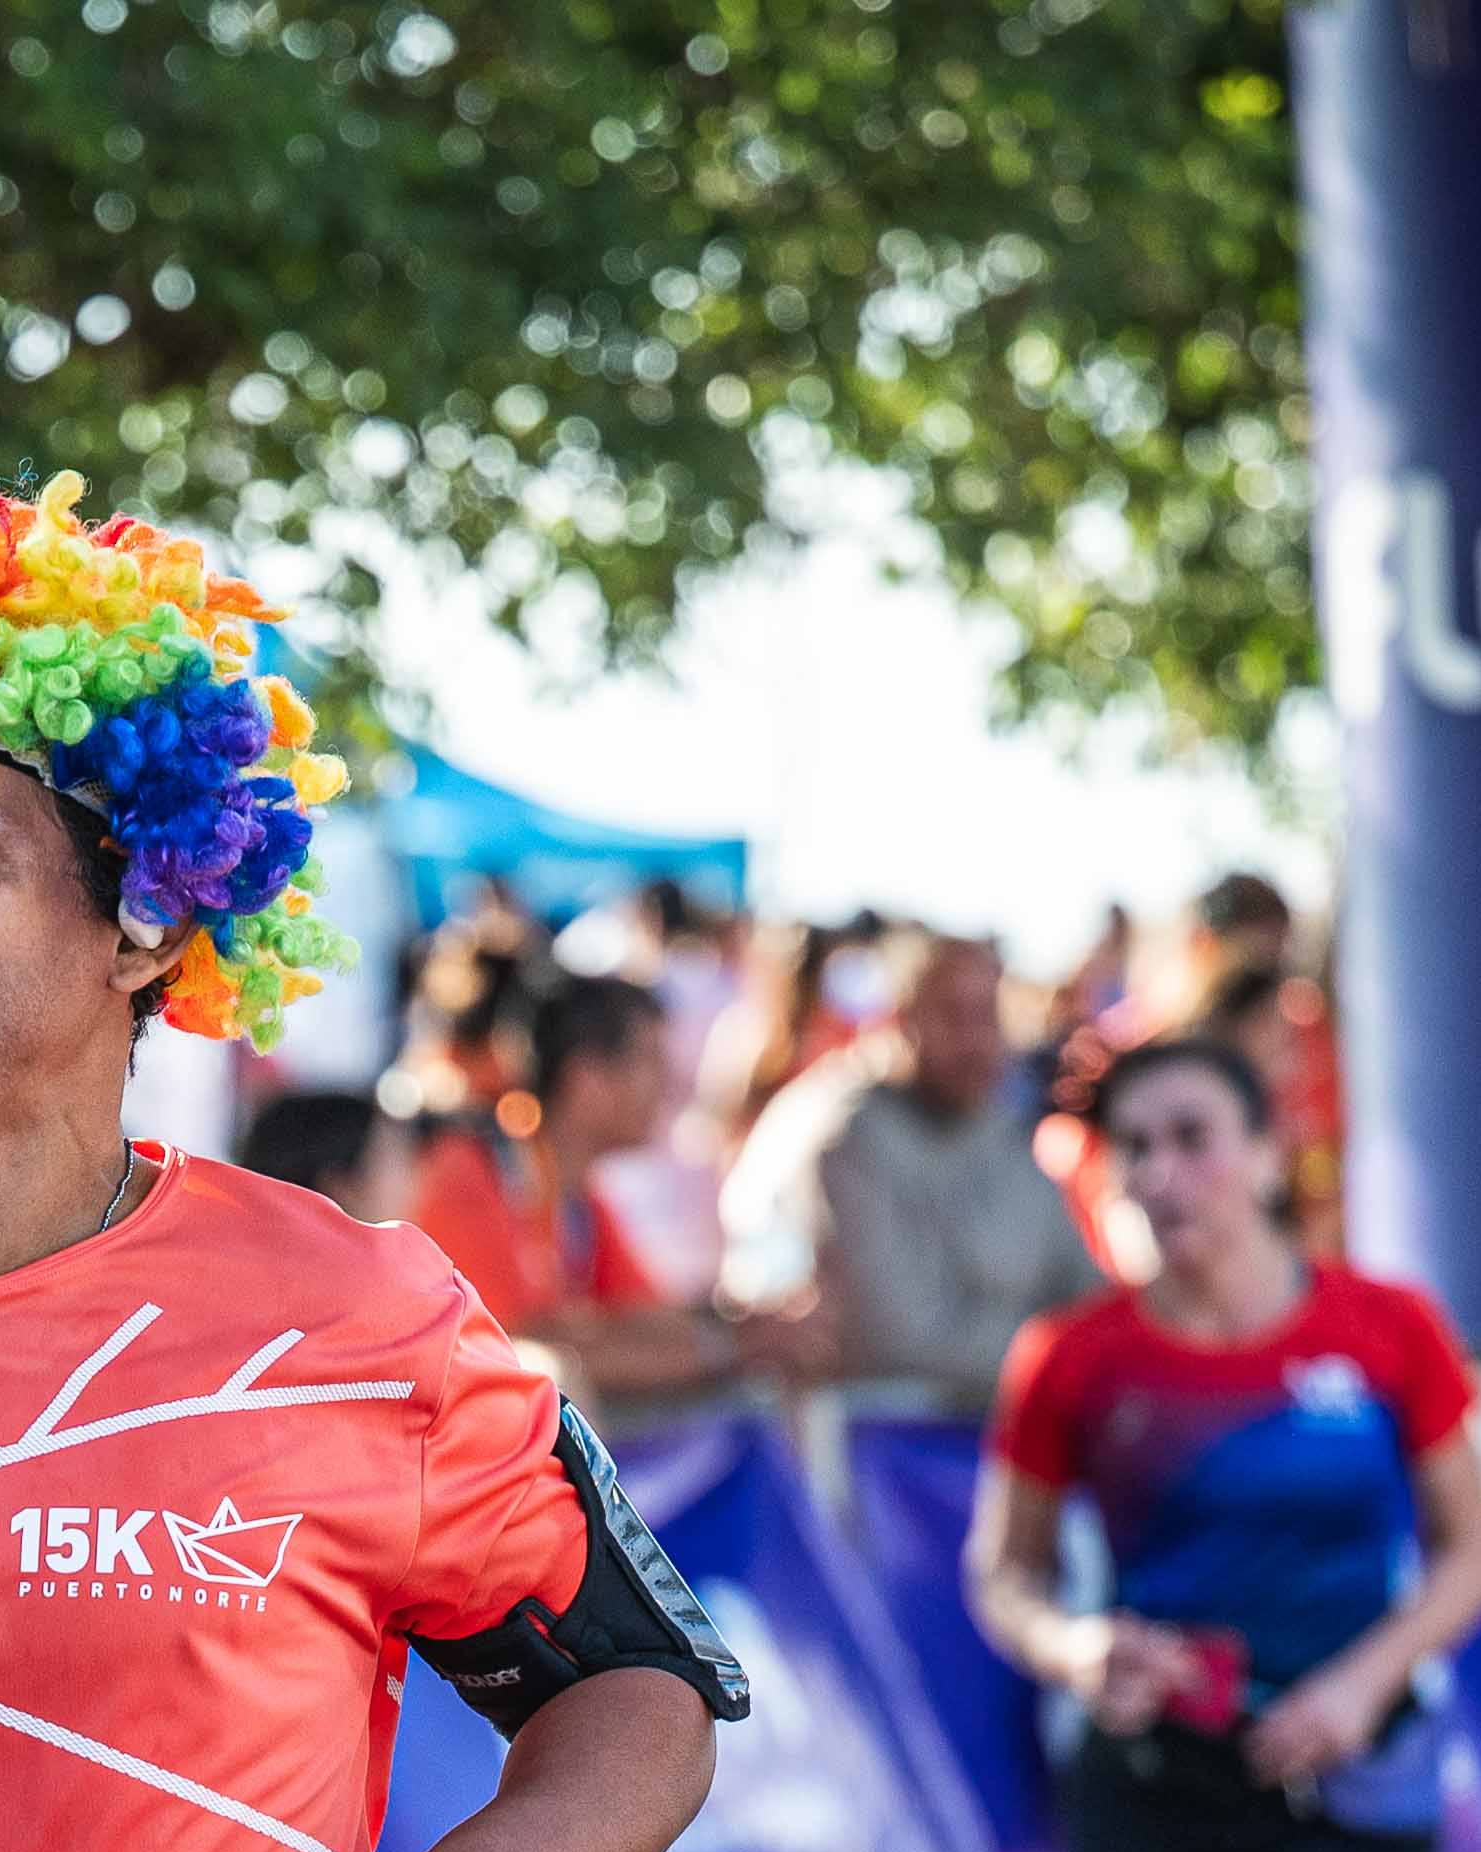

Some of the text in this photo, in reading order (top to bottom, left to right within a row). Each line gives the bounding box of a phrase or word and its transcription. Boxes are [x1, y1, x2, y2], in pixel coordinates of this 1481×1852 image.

[10, 1507, 157, 1576] 15K
[19, 1581, 268, 1612] PUERTO NORTE
